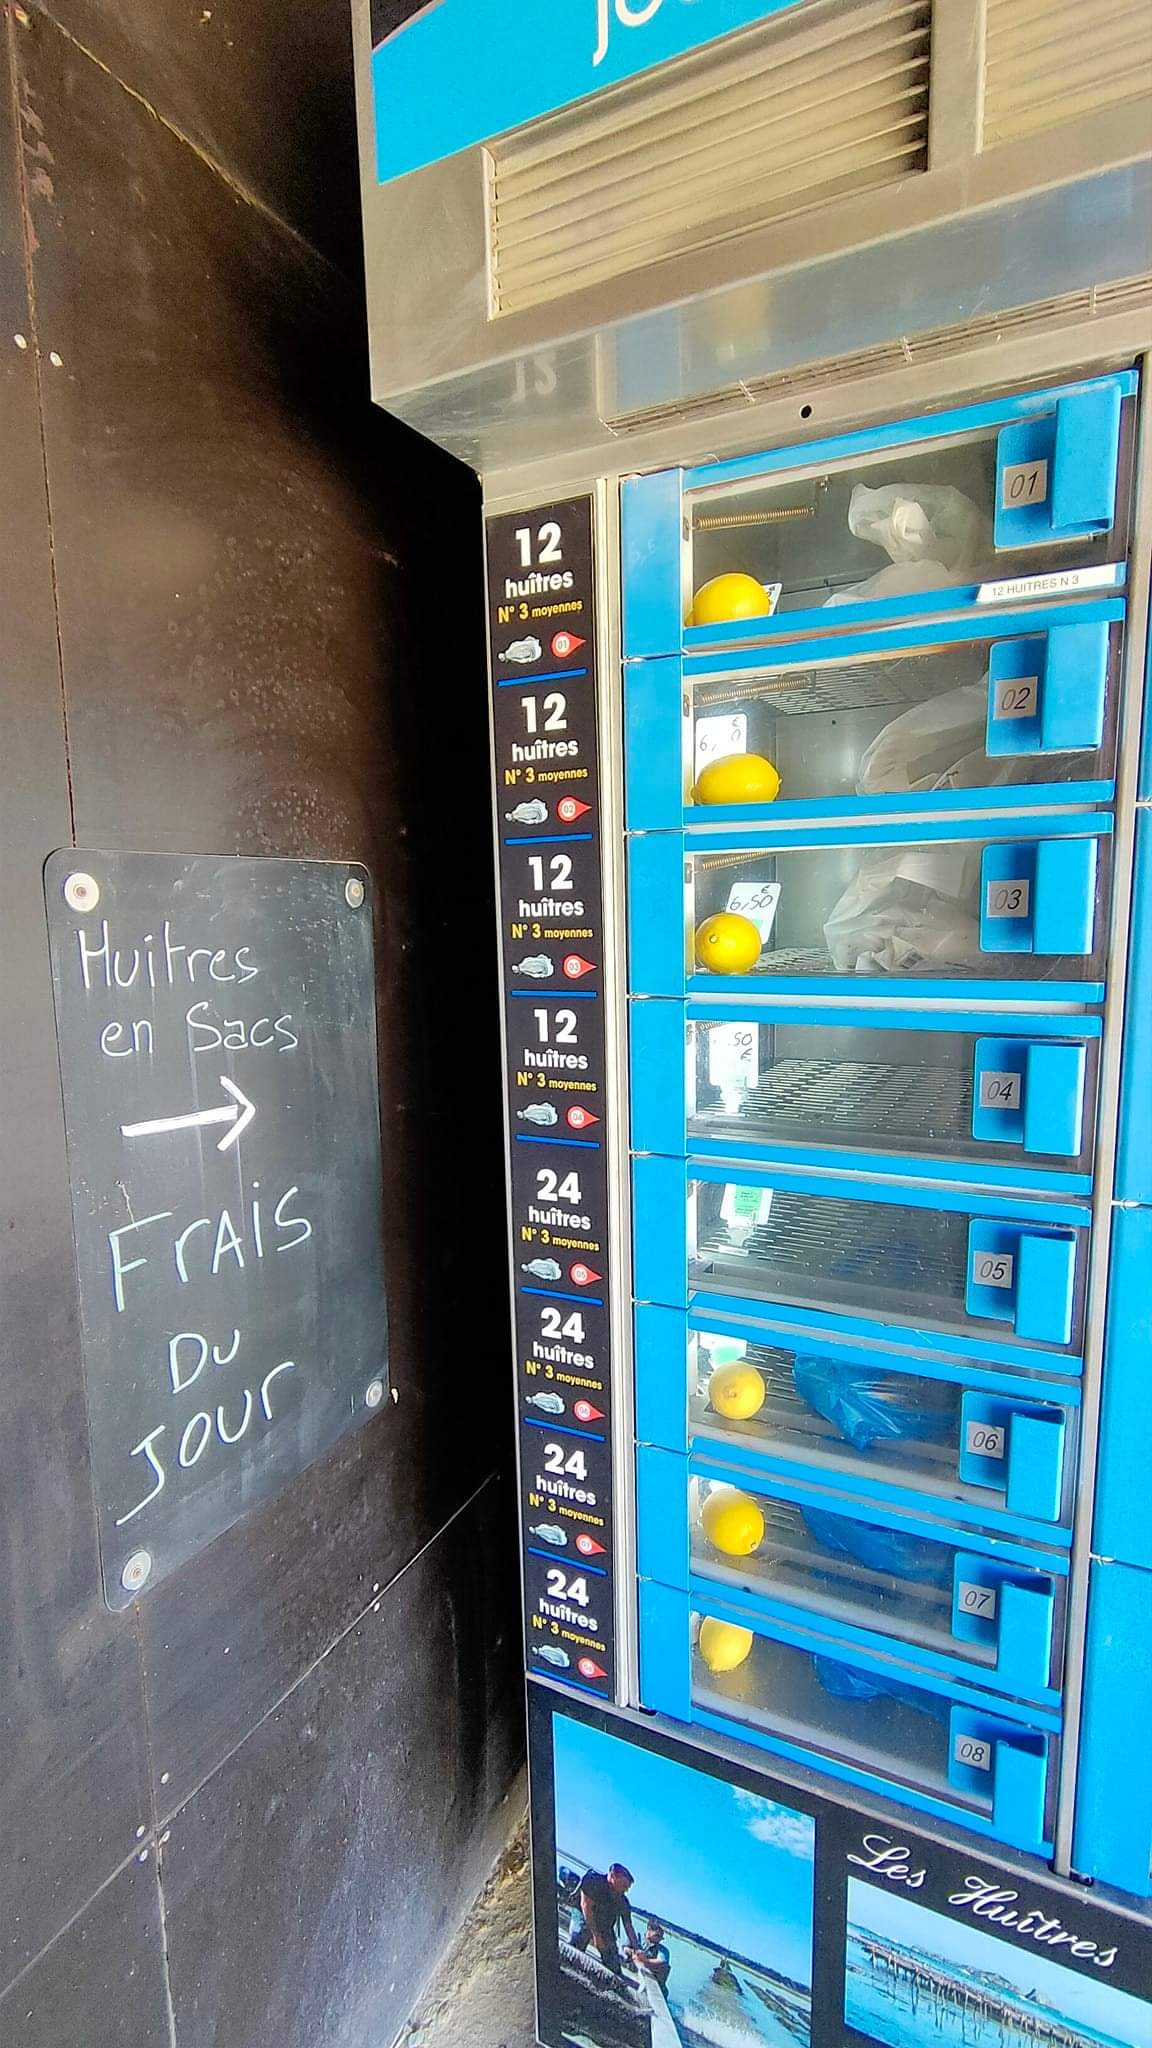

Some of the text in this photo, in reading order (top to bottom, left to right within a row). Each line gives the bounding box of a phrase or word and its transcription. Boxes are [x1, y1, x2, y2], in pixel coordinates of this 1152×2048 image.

[1009, 470, 1039, 499] 01
[515, 522, 562, 567] 12
[505, 571, 574, 599] huîtres
[992, 575, 1080, 597] 12 HUITRES N 3
[519, 603, 529, 620] 3
[531, 600, 583, 618] moyennes
[1001, 686, 1030, 711] 02
[521, 692, 567, 733] 12
[511, 739, 579, 762] huîtres
[526, 767, 535, 783] 3
[538, 768, 588, 782] moyennes
[528, 854, 573, 891] 12
[519, 897, 584, 917] huîtres
[730, 894, 774, 912] 6,50
[993, 889, 1022, 911] 03
[532, 923, 541, 938] 3
[544, 928, 593, 940] moyennes
[77, 920, 258, 989] Huitres
[101, 1001, 298, 1057] en Sacs
[534, 1009, 577, 1043] 12
[524, 1049, 588, 1069] huîtres
[537, 1073, 546, 1087] 3
[548, 1080, 597, 1091] moyennes
[987, 1079, 1013, 1101] 04
[536, 1169, 581, 1204] 24
[528, 1206, 591, 1230] huîtres
[541, 1229, 550, 1243] 3
[552, 1236, 600, 1251] moyennes
[979, 1259, 1005, 1281] 05
[541, 1307, 585, 1344] 24
[533, 1341, 594, 1369] huîtres
[545, 1365, 554, 1379] 3
[556, 1373, 603, 1390] moyennes
[973, 1430, 998, 1451] 06
[544, 1443, 587, 1481] 24
[536, 1474, 597, 1505] huîtres
[548, 1499, 556, 1512] 3
[559, 1506, 604, 1526] moyennes
[547, 1569, 589, 1607] 24
[964, 1590, 990, 1610] 07
[539, 1598, 598, 1631] huîtres
[551, 1622, 559, 1634] 3
[561, 1630, 606, 1652] moyennes
[960, 1742, 985, 1763] 08
[847, 1834, 1119, 1967] Les Huîtres
